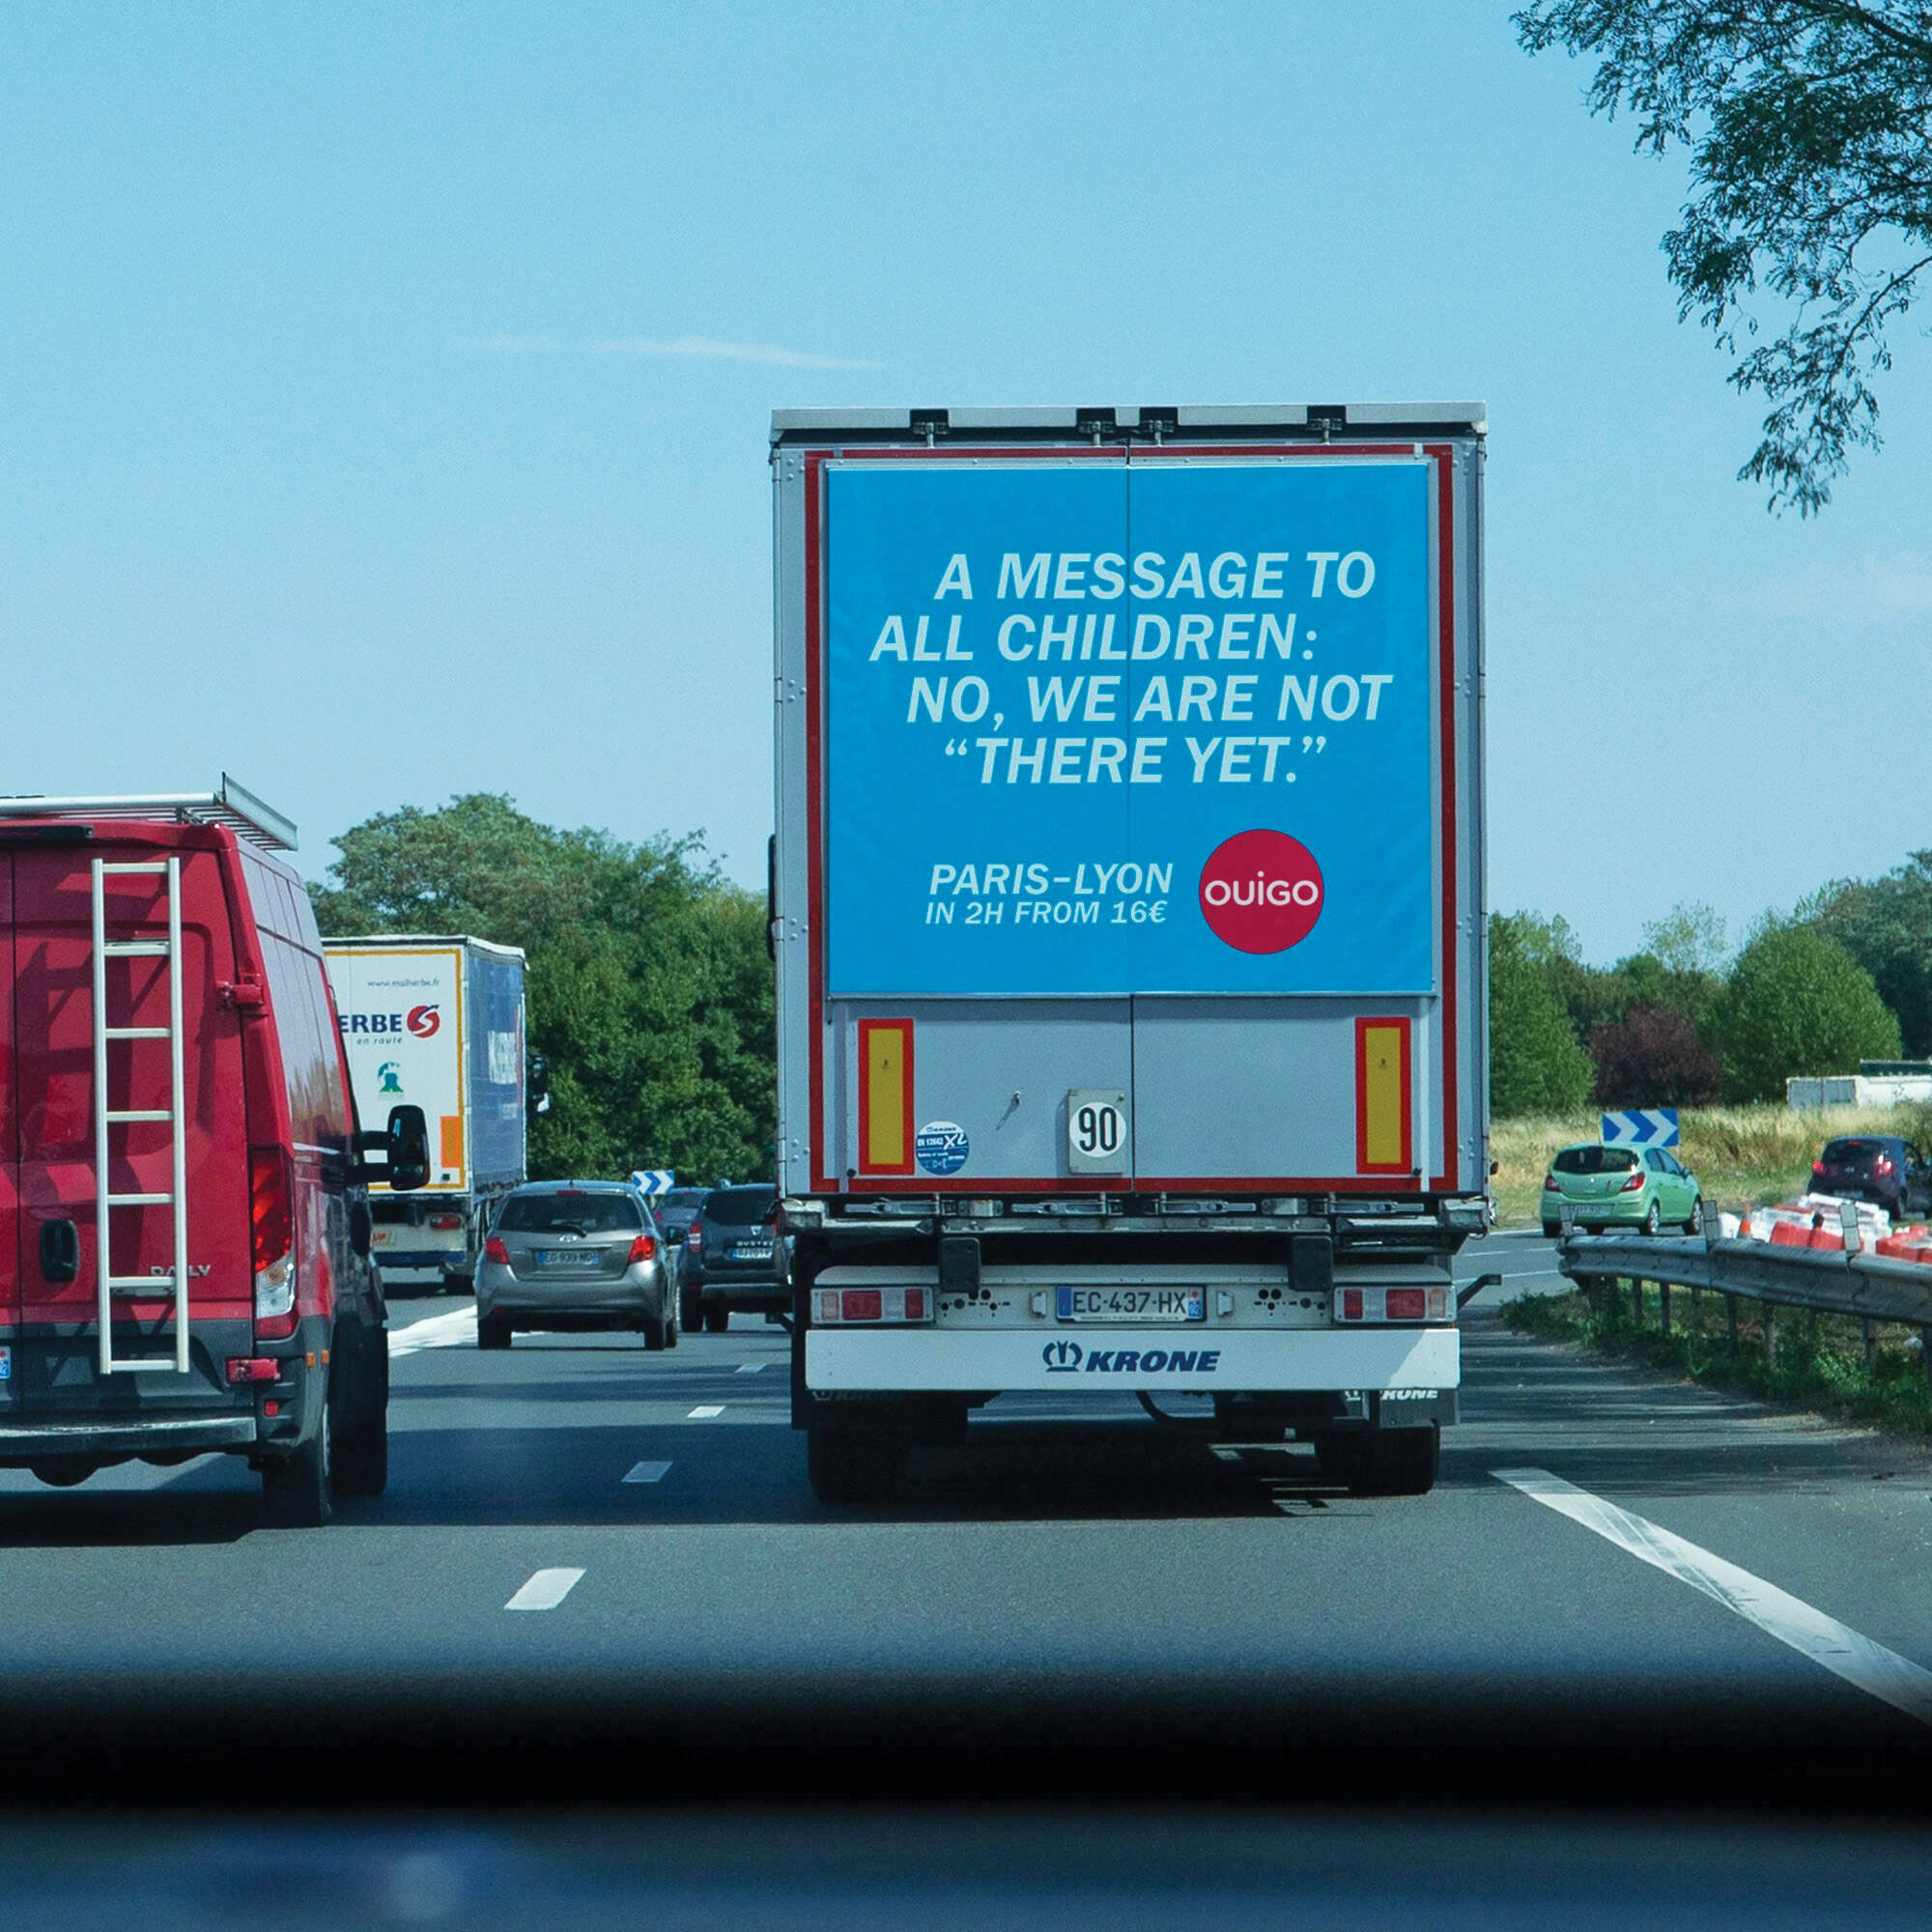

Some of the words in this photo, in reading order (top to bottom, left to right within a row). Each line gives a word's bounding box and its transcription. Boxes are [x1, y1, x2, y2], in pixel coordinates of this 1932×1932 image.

[934, 554, 973, 599] A
[996, 552, 1290, 600] MESSAGE
[1306, 551, 1376, 598] TO
[869, 614, 974, 662] ALL
[998, 613, 1318, 662] CHILDREN:
[907, 675, 1004, 731] NO,
[1027, 675, 1122, 723] WE
[1133, 674, 1259, 722] ARE
[1277, 674, 1394, 722] NOT
[945, 737, 1168, 783] “THERE
[1185, 735, 1326, 783] YET.”
[929, 863, 1173, 895] PARIS-LYON
[925, 902, 954, 924] IN
[964, 901, 1004, 924] 2H
[1015, 901, 1099, 923] FROM
[1111, 900, 1168, 923] 16€
[338, 1013, 403, 1034] ERBE
[1079, 1107, 1117, 1151] 90
[943, 1133, 967, 1151] XL
[151, 1264, 211, 1276] DALY
[1073, 1292, 1186, 1314] EC-437-HX
[1085, 1350, 1221, 1373] KRONE
[1379, 1389, 1438, 1401] RONE
